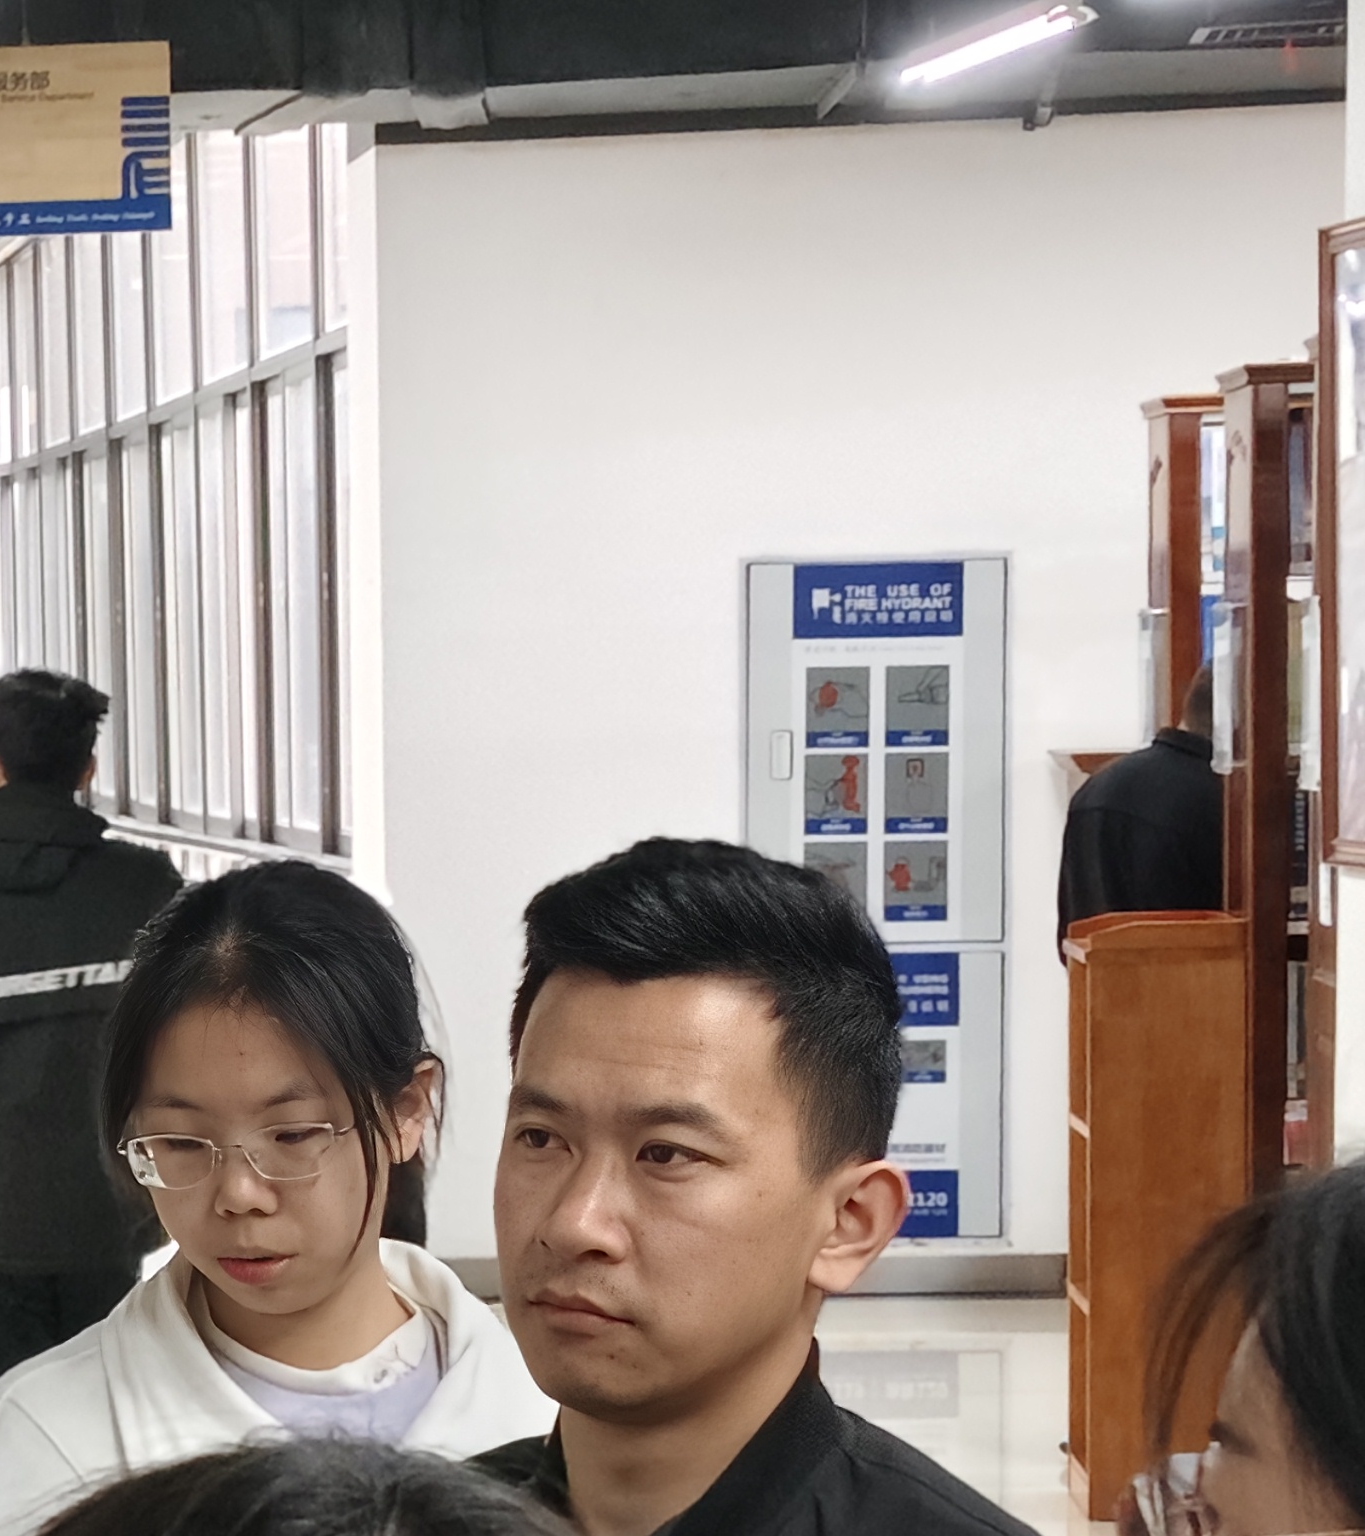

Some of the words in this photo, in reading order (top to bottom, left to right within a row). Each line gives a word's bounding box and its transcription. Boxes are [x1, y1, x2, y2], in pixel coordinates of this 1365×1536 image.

[844, 584, 877, 598] THE
[886, 583, 920, 598] USE
[929, 582, 953, 597] OF
[844, 597, 878, 611] FIRE
[880, 596, 953, 611] HYDRANT
